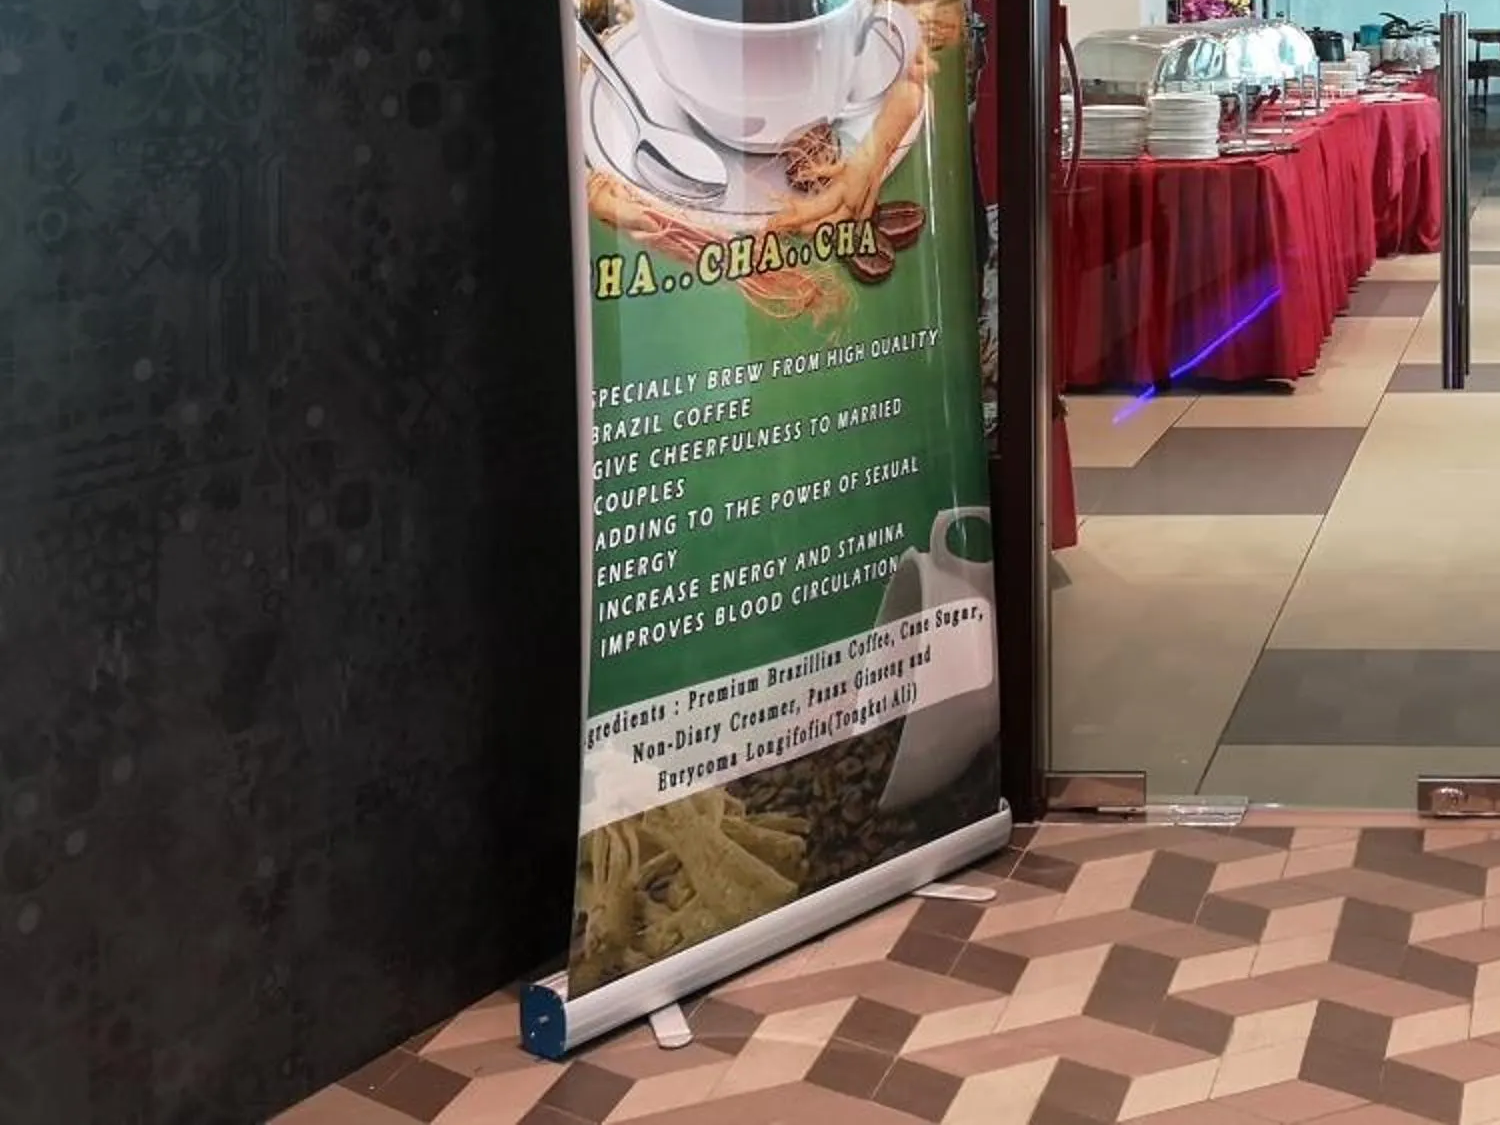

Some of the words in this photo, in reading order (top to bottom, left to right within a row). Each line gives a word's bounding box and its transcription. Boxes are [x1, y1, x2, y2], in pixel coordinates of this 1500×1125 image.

[707, 362, 764, 390] BREW
[773, 353, 819, 378] FROM
[828, 343, 865, 367] HIGH
[871, 328, 939, 357] QUALITY
[592, 415, 662, 445] BRAZIL
[673, 398, 751, 428] COFFEE
[592, 453, 638, 479] GIVE
[649, 424, 801, 468] CHEERFULNESS
[810, 415, 830, 436] TO
[838, 398, 901, 428] MARRIED
[594, 479, 685, 515] COUPLES
[595, 517, 677, 551] ADDING
[688, 506, 713, 529] TO
[724, 495, 761, 520] THE
[771, 478, 831, 507] POWER
[838, 474, 858, 491] OF
[865, 456, 919, 485] SEXUAL
[597, 549, 678, 587] ENERGY
[598, 582, 699, 621] INCREASE
[710, 556, 788, 593] ENERGY
[796, 543, 830, 571] AND
[837, 522, 905, 558] STAMINA
[601, 614, 705, 658] IMPROVES
[715, 593, 783, 627] BLOOD
[791, 556, 898, 605] CIRCULATION
[910, 645, 931, 668] and
[584, 704, 666, 750] gredients
[688, 676, 759, 710] Premium
